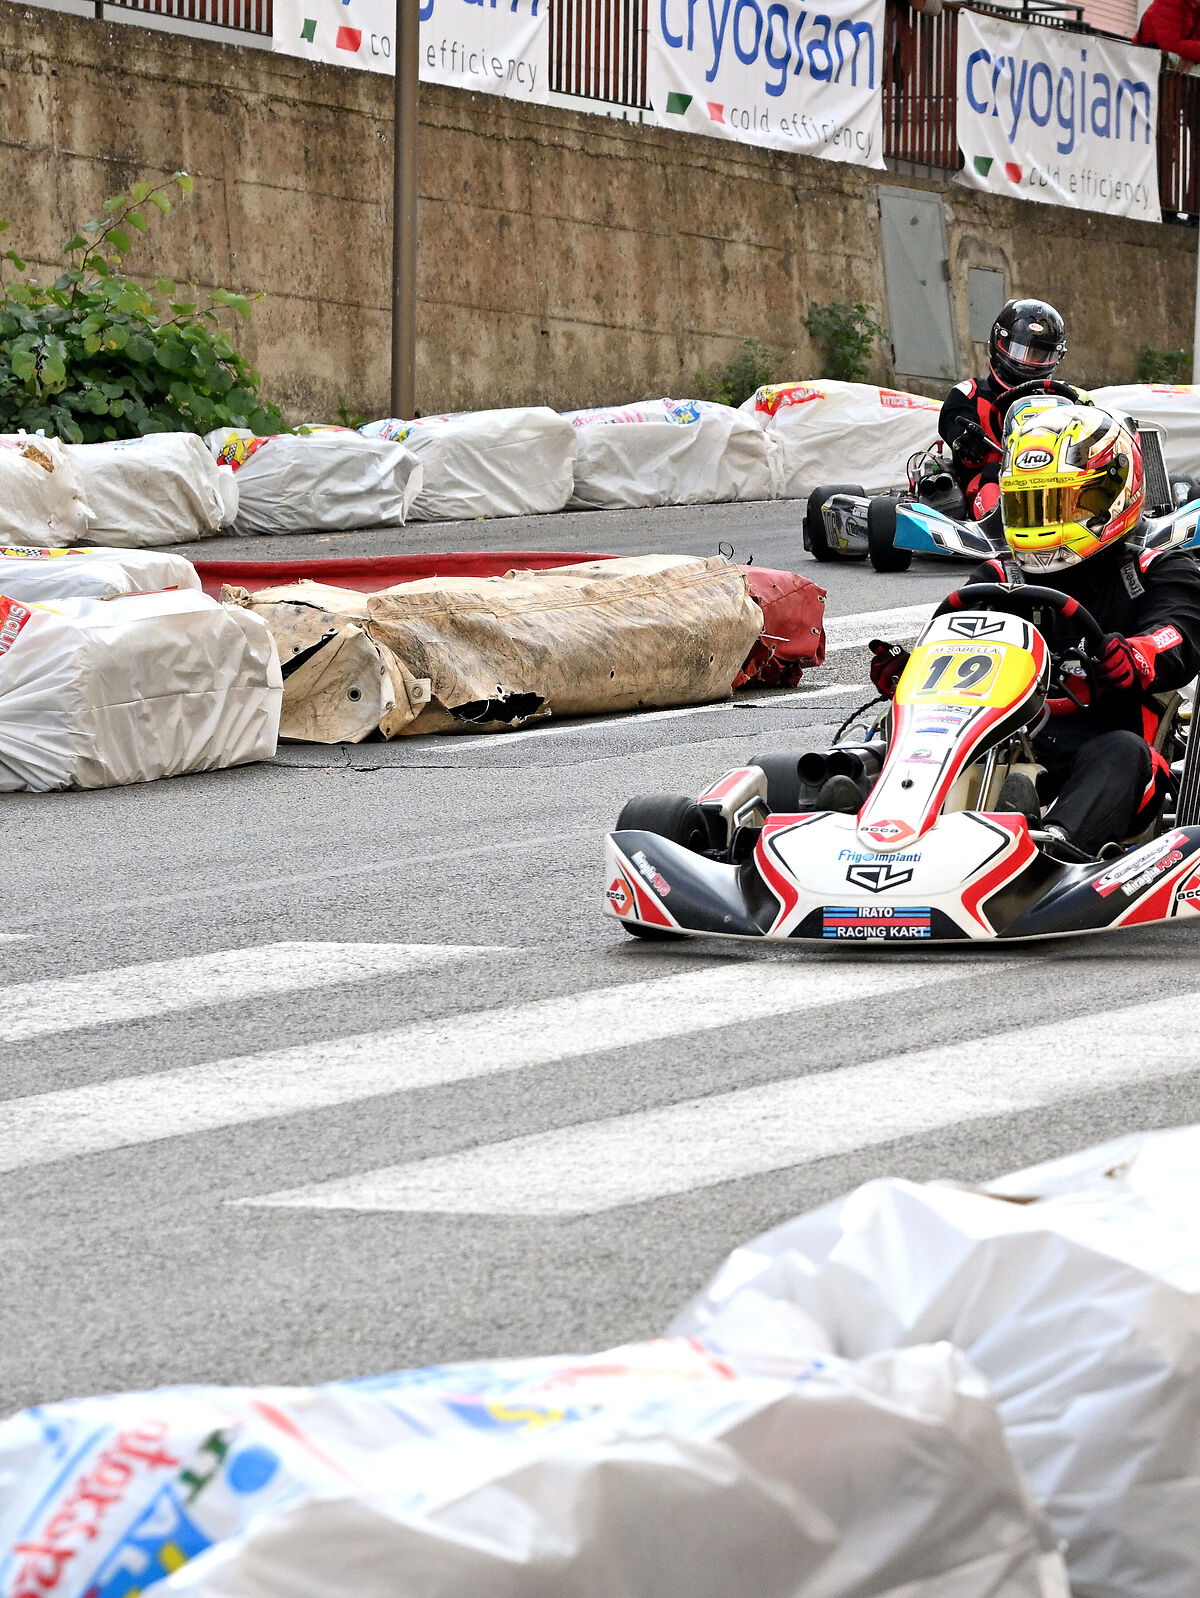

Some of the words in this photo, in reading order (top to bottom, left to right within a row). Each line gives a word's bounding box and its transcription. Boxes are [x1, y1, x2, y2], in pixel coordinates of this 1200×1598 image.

[426, 39, 538, 92] efficiency
[660, 0, 876, 97] cryogiam
[966, 48, 1151, 155] cryogiam
[730, 105, 770, 133] cold
[780, 113, 874, 158] efficiency
[1070, 168, 1150, 210] efficiency
[1016, 451, 1049, 465] Arai
[919, 654, 995, 691] 19
[606, 891, 625, 901] acca
[858, 907, 894, 918] IRATO
[837, 927, 887, 938] RACING
[890, 927, 926, 938] KART
